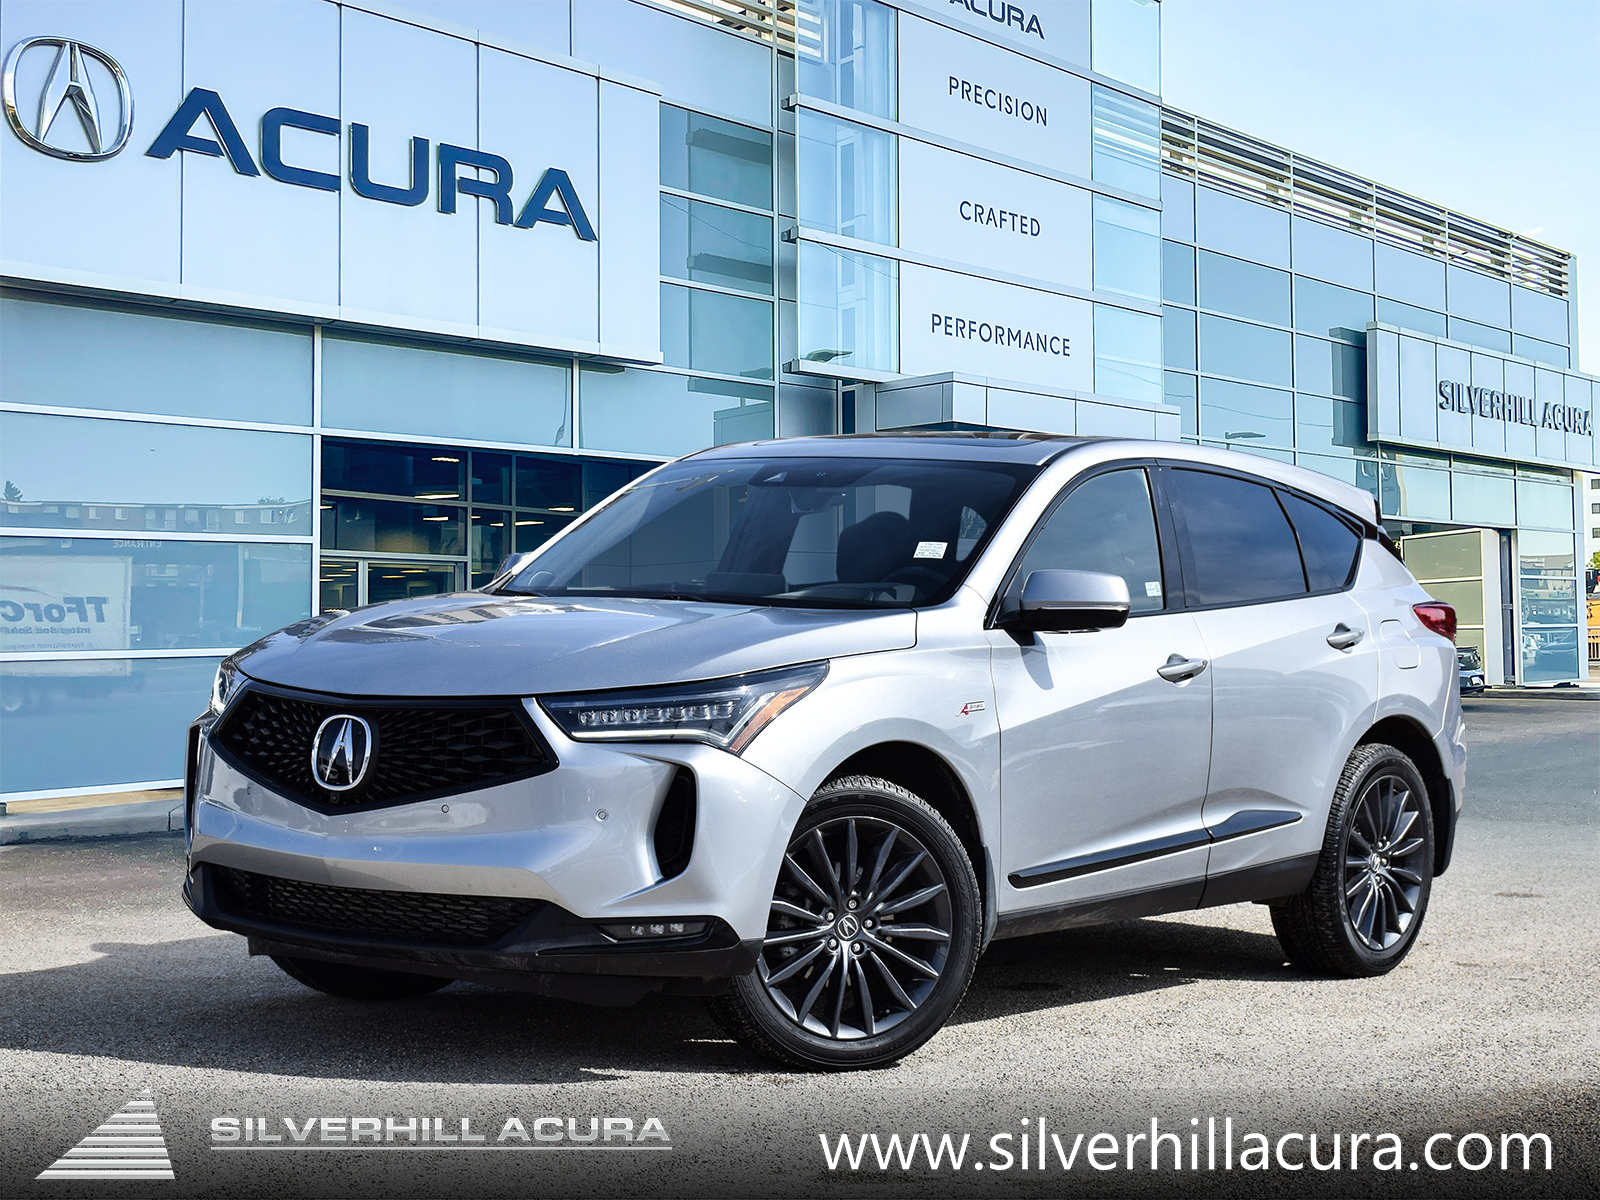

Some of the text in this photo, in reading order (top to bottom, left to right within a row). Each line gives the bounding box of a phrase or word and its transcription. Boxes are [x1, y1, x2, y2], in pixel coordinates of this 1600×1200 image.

[948, 75, 1048, 127] PRECISION
[144, 86, 599, 242] ACURA
[959, 200, 1041, 237] CRAFTED
[931, 313, 1071, 357] PERFORMANCE
[1439, 379, 1594, 437] SILVERHILL ACURA
